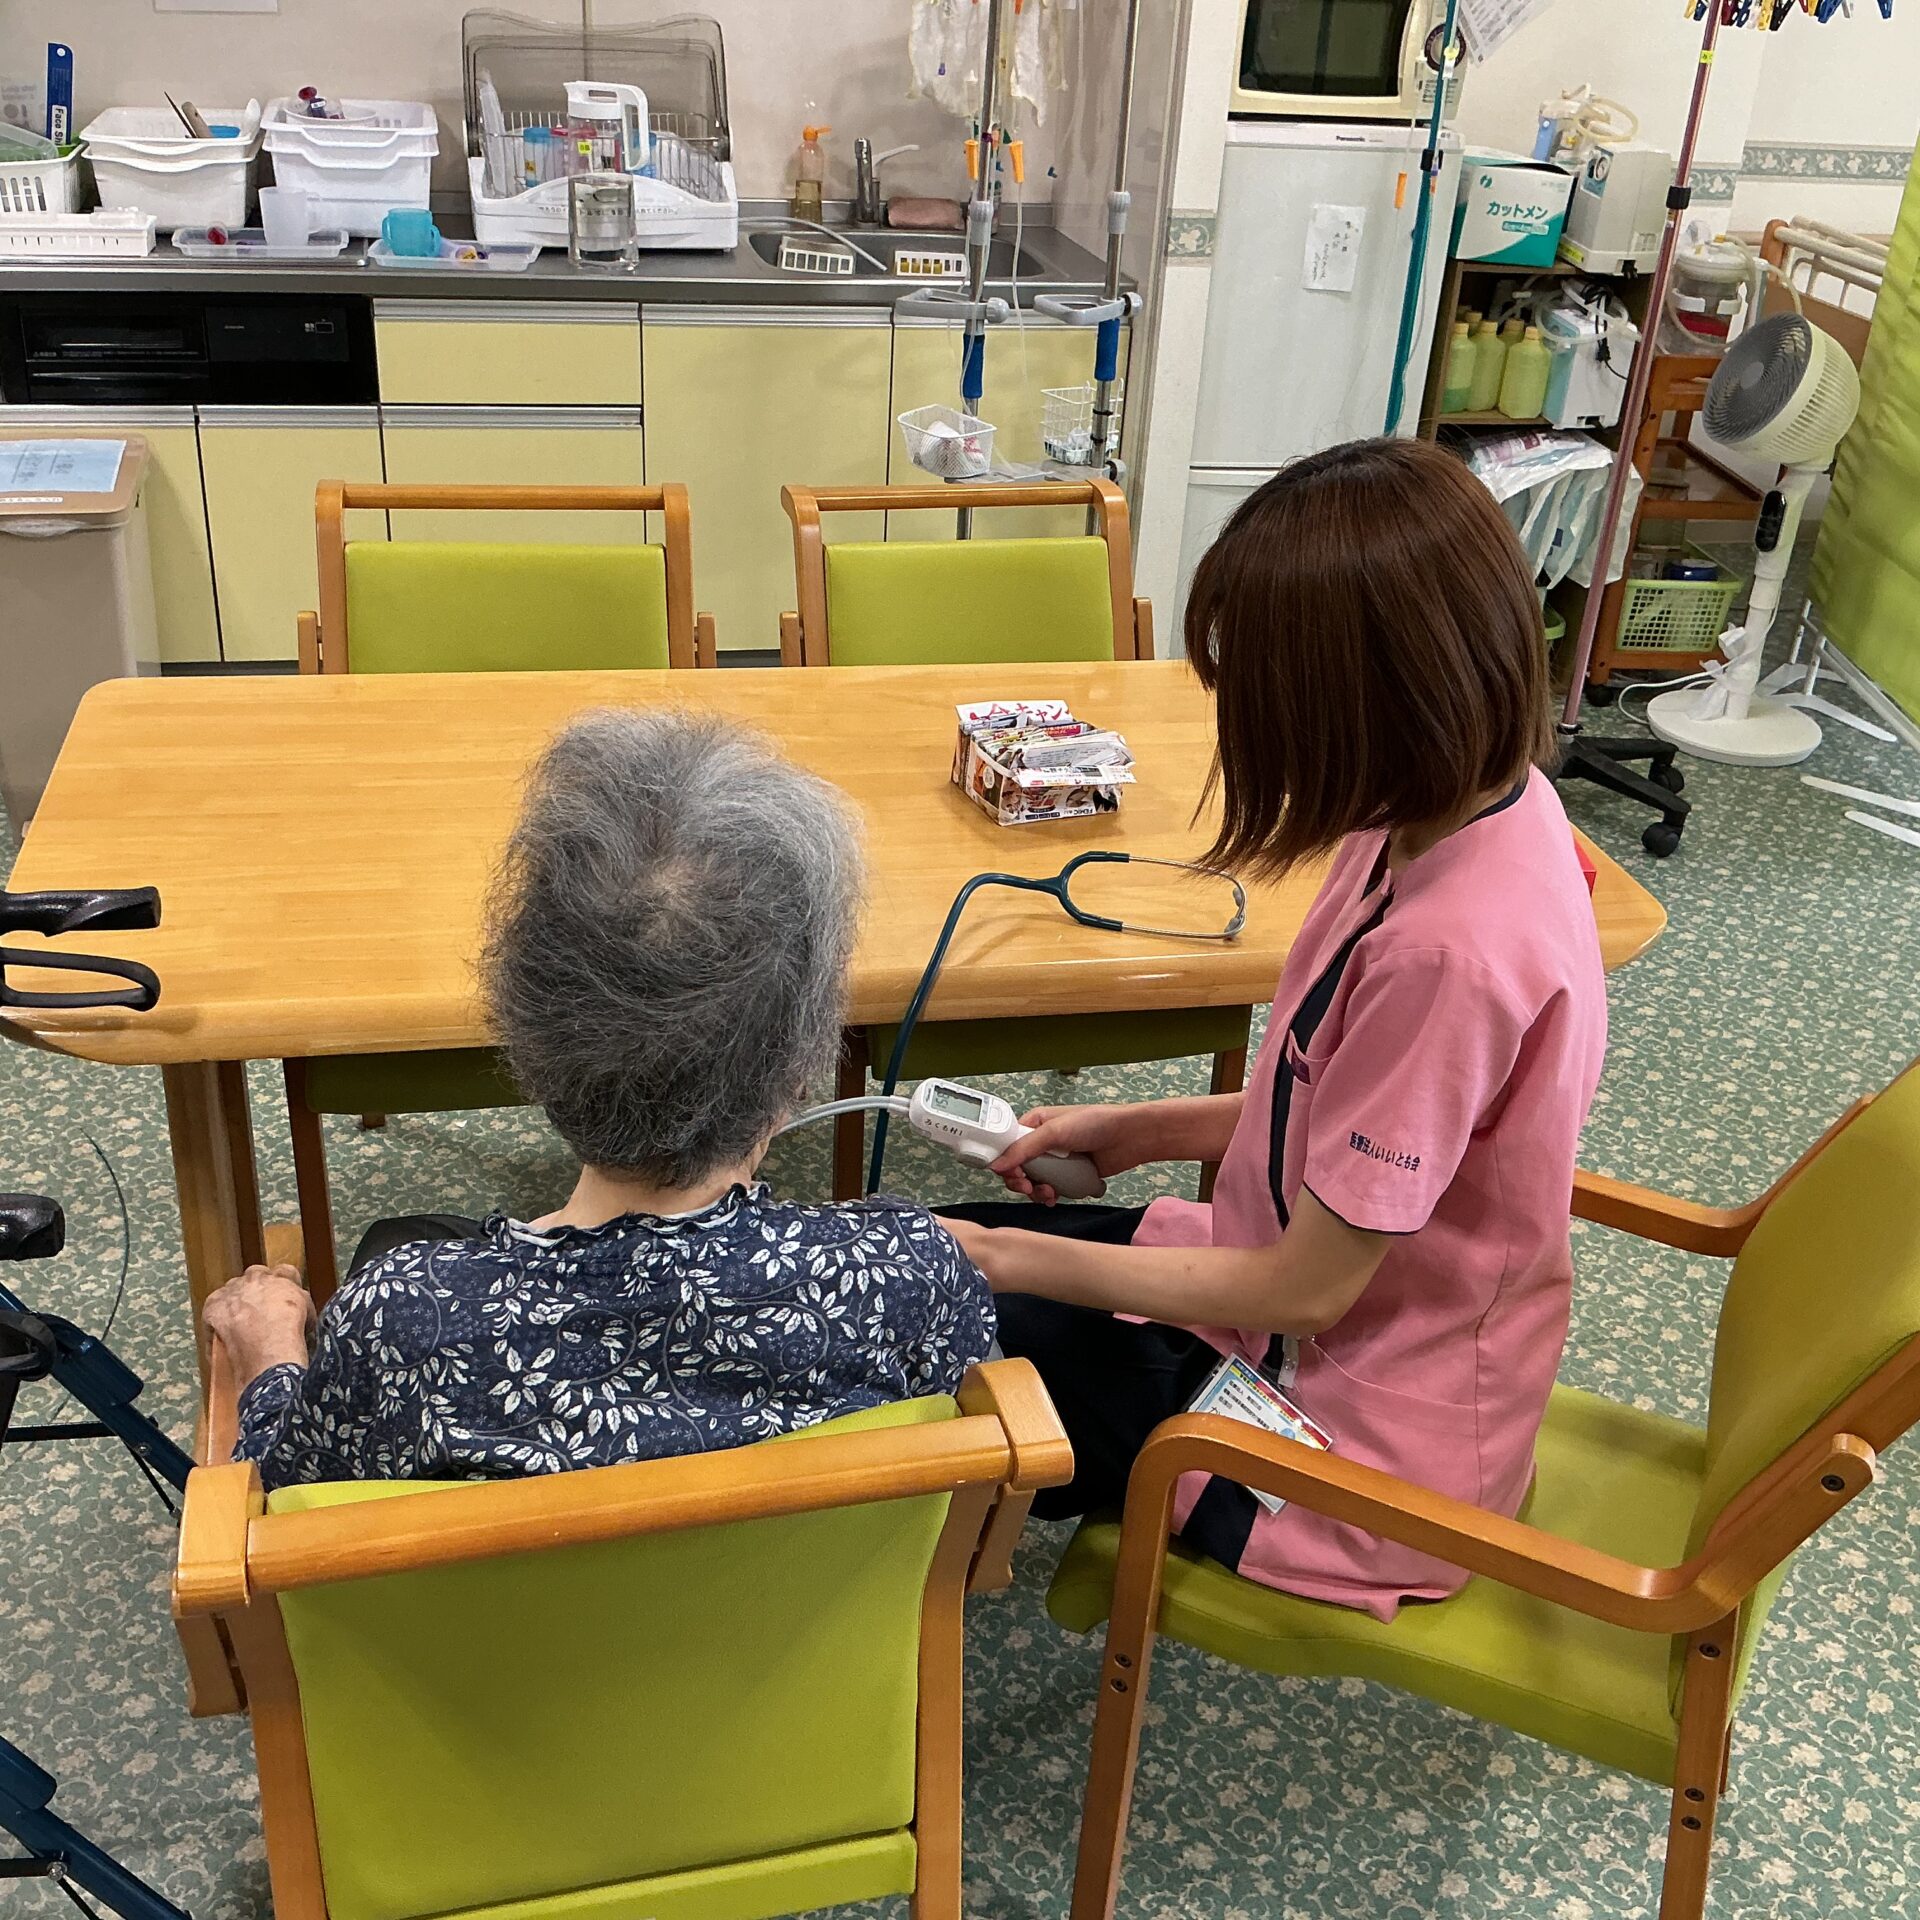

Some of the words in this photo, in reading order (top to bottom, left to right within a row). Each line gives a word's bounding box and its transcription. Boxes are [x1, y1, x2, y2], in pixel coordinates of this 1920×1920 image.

[55, 108, 64, 129] Face
[1486, 201, 1548, 220] カットメン
